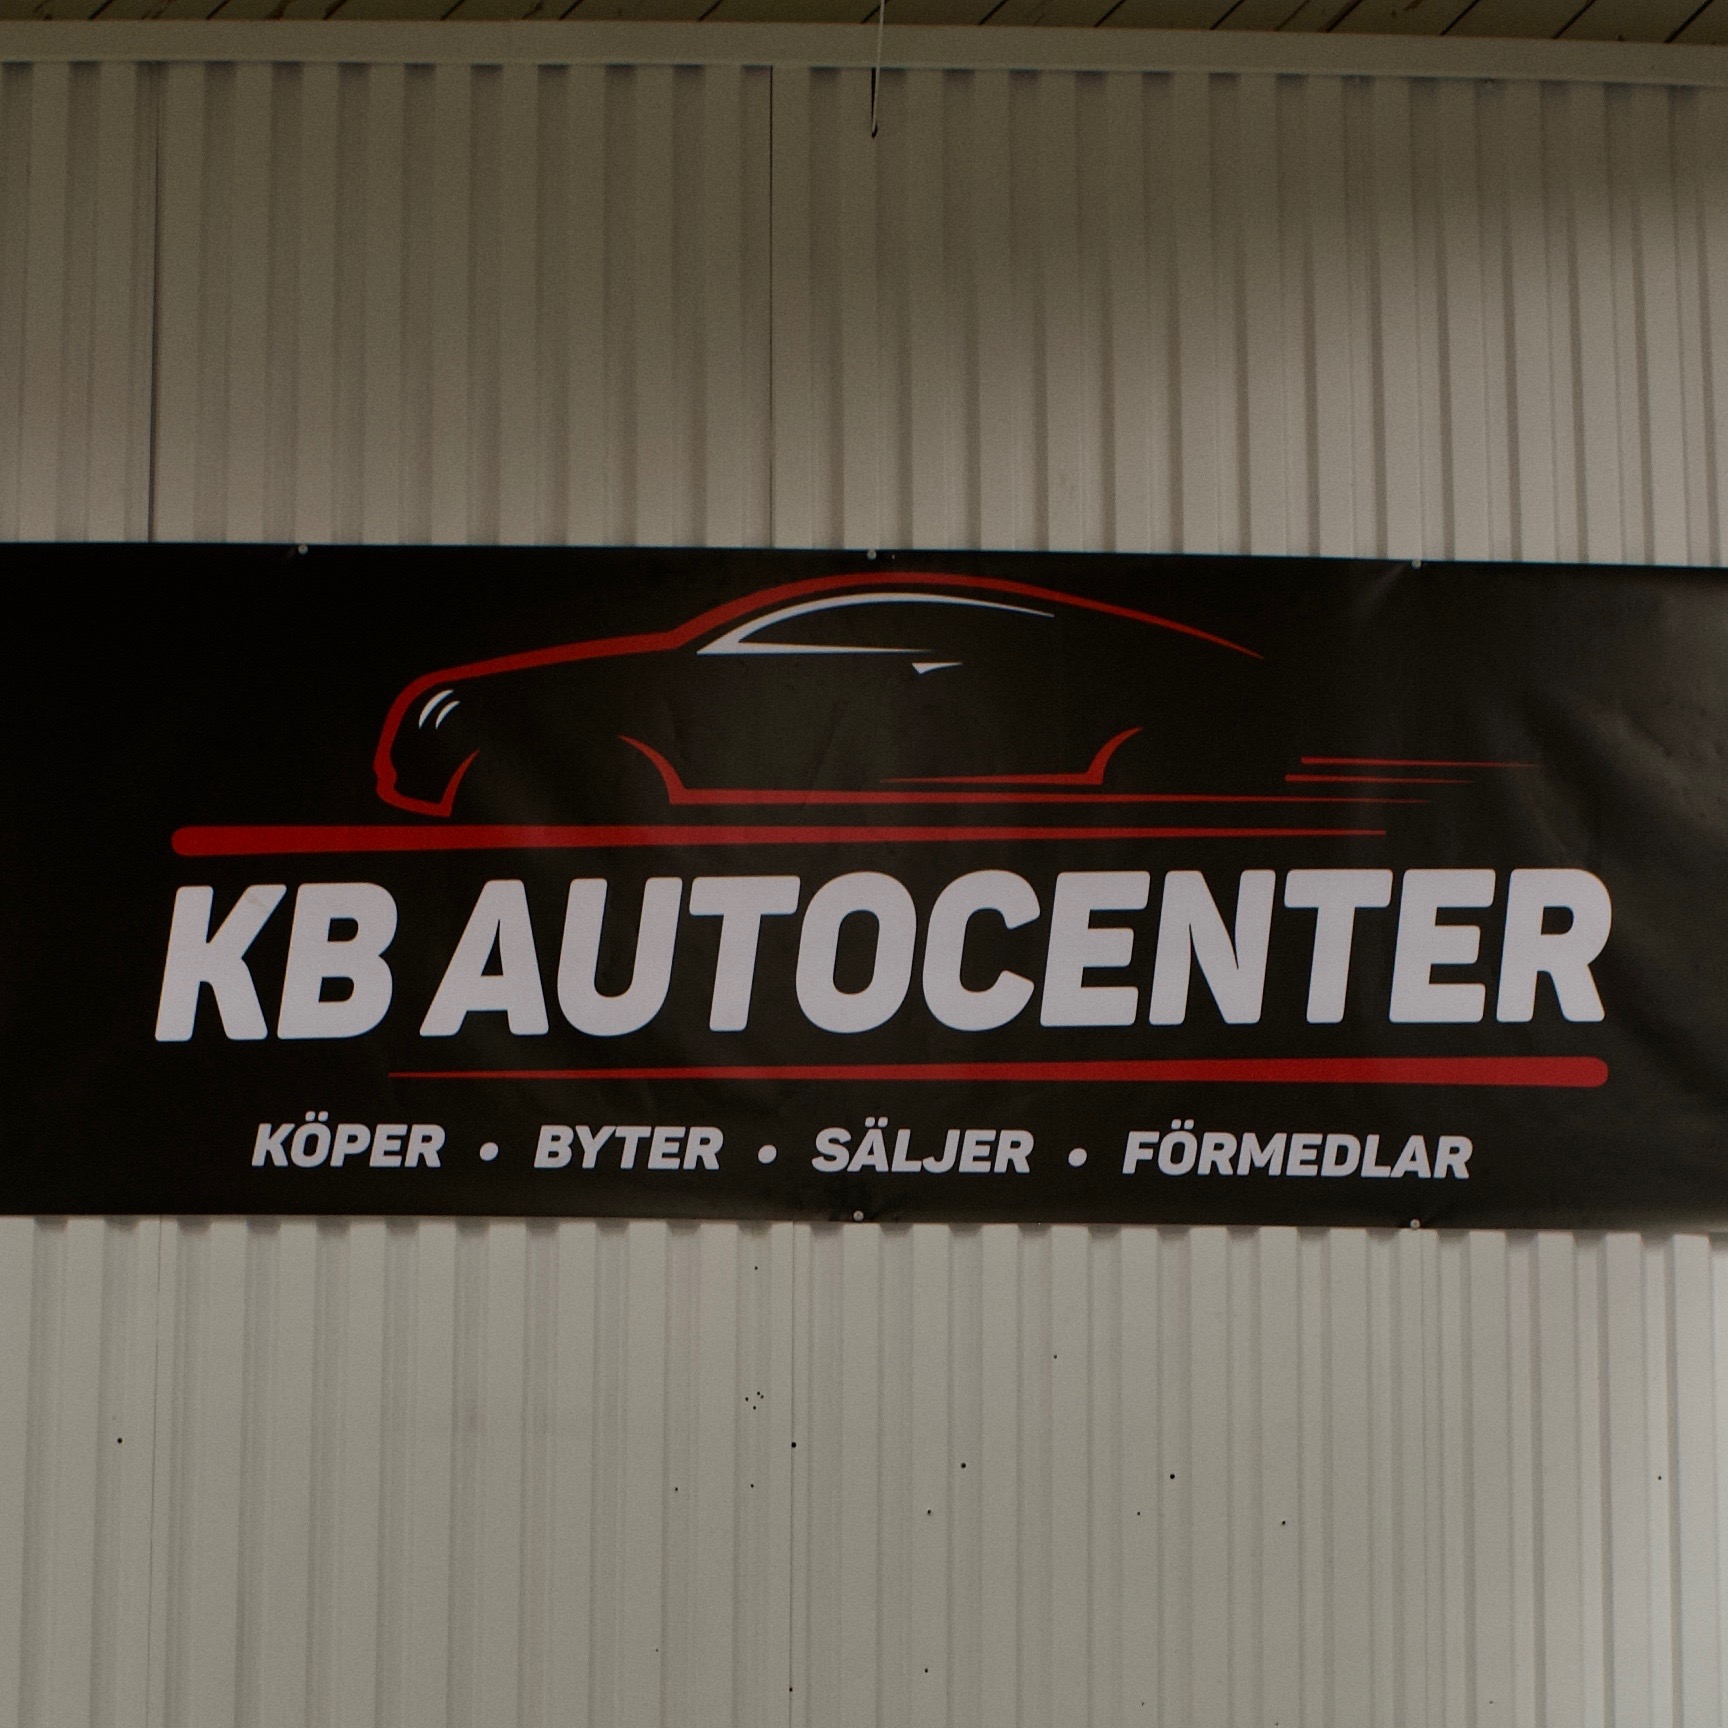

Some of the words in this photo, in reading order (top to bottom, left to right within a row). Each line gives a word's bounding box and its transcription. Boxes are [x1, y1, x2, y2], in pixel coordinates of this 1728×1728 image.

[154, 882, 398, 1042] KB
[419, 868, 1612, 1037] AUTOCENTER
[251, 1110, 446, 1168] KÖPER
[533, 1124, 724, 1170] BYTER
[811, 1116, 1035, 1174] SÄLJER
[1122, 1118, 1473, 1179] FÖRMEDLAR
